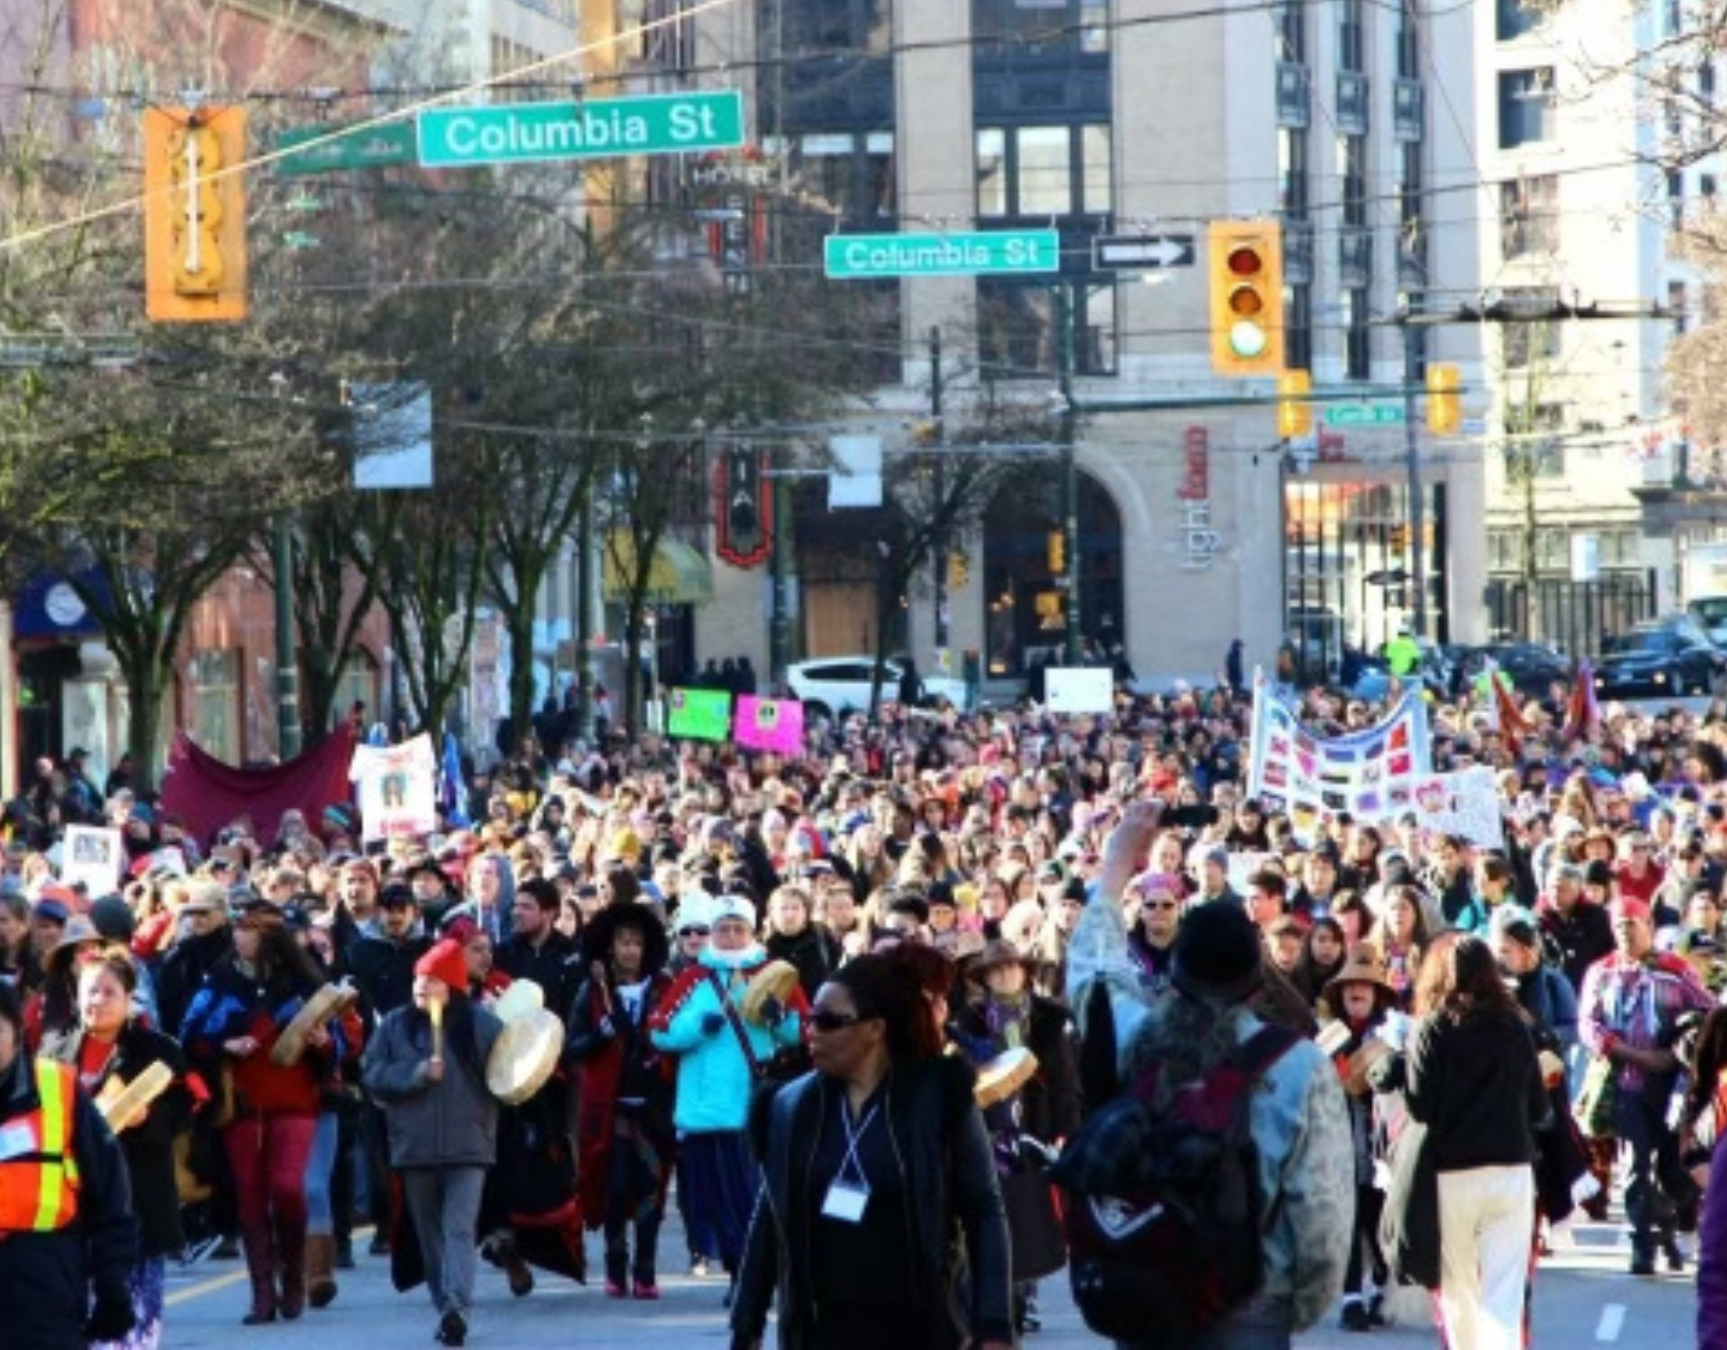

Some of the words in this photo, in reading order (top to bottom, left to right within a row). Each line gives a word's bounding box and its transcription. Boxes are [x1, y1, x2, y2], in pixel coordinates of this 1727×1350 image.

[444, 107, 648, 154] Columbia
[668, 104, 718, 141] St
[844, 239, 991, 270] Columbia
[1004, 237, 1038, 265] St
